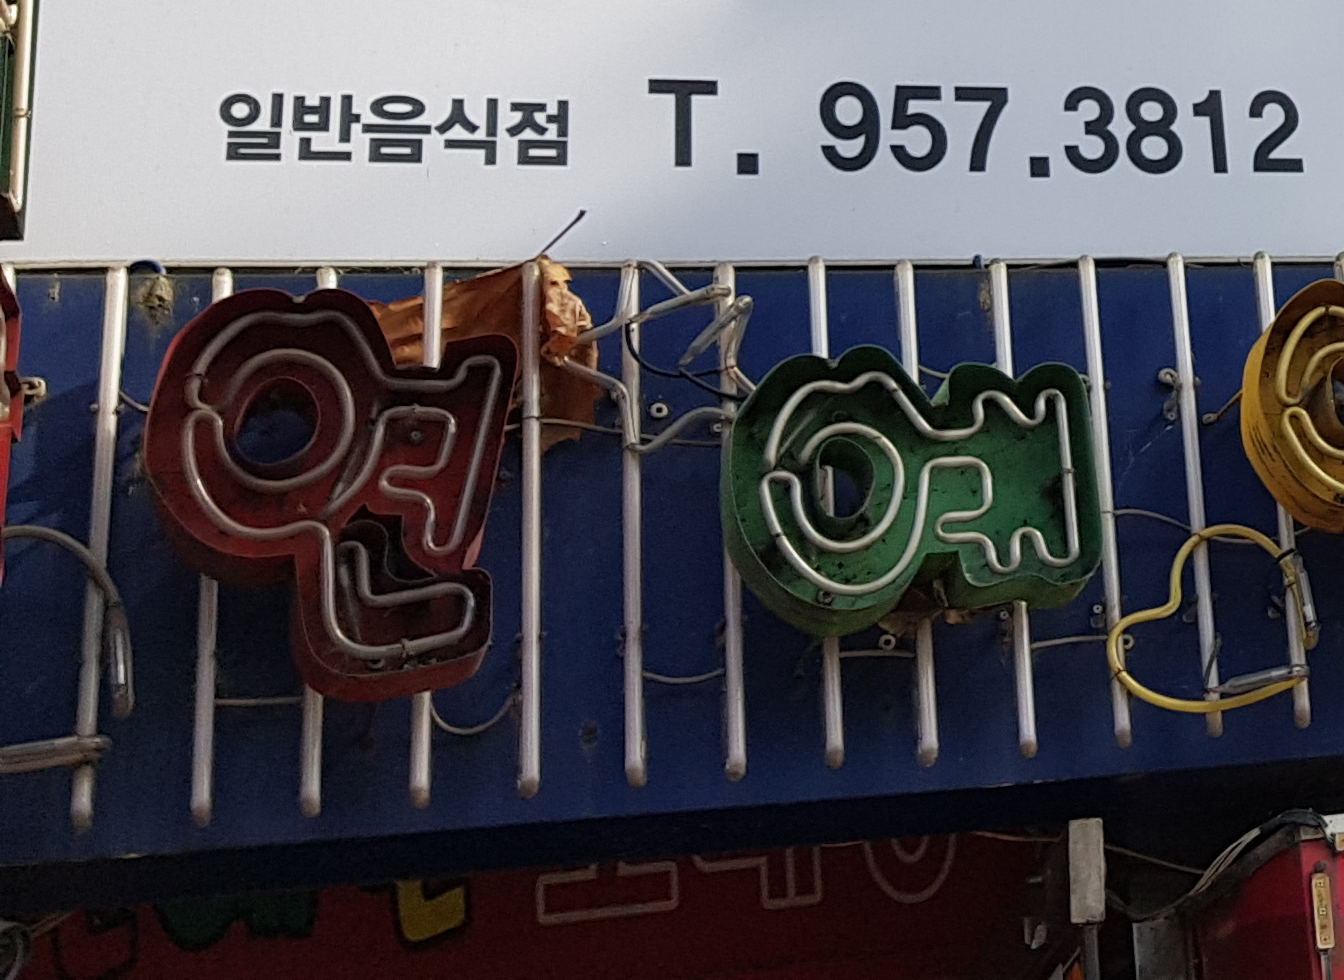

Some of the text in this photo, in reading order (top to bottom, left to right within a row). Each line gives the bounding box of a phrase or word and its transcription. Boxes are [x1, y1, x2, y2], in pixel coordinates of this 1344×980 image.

[219, 92, 569, 167] 일반음식점
[648, 78, 1305, 178] T. 957.3812
